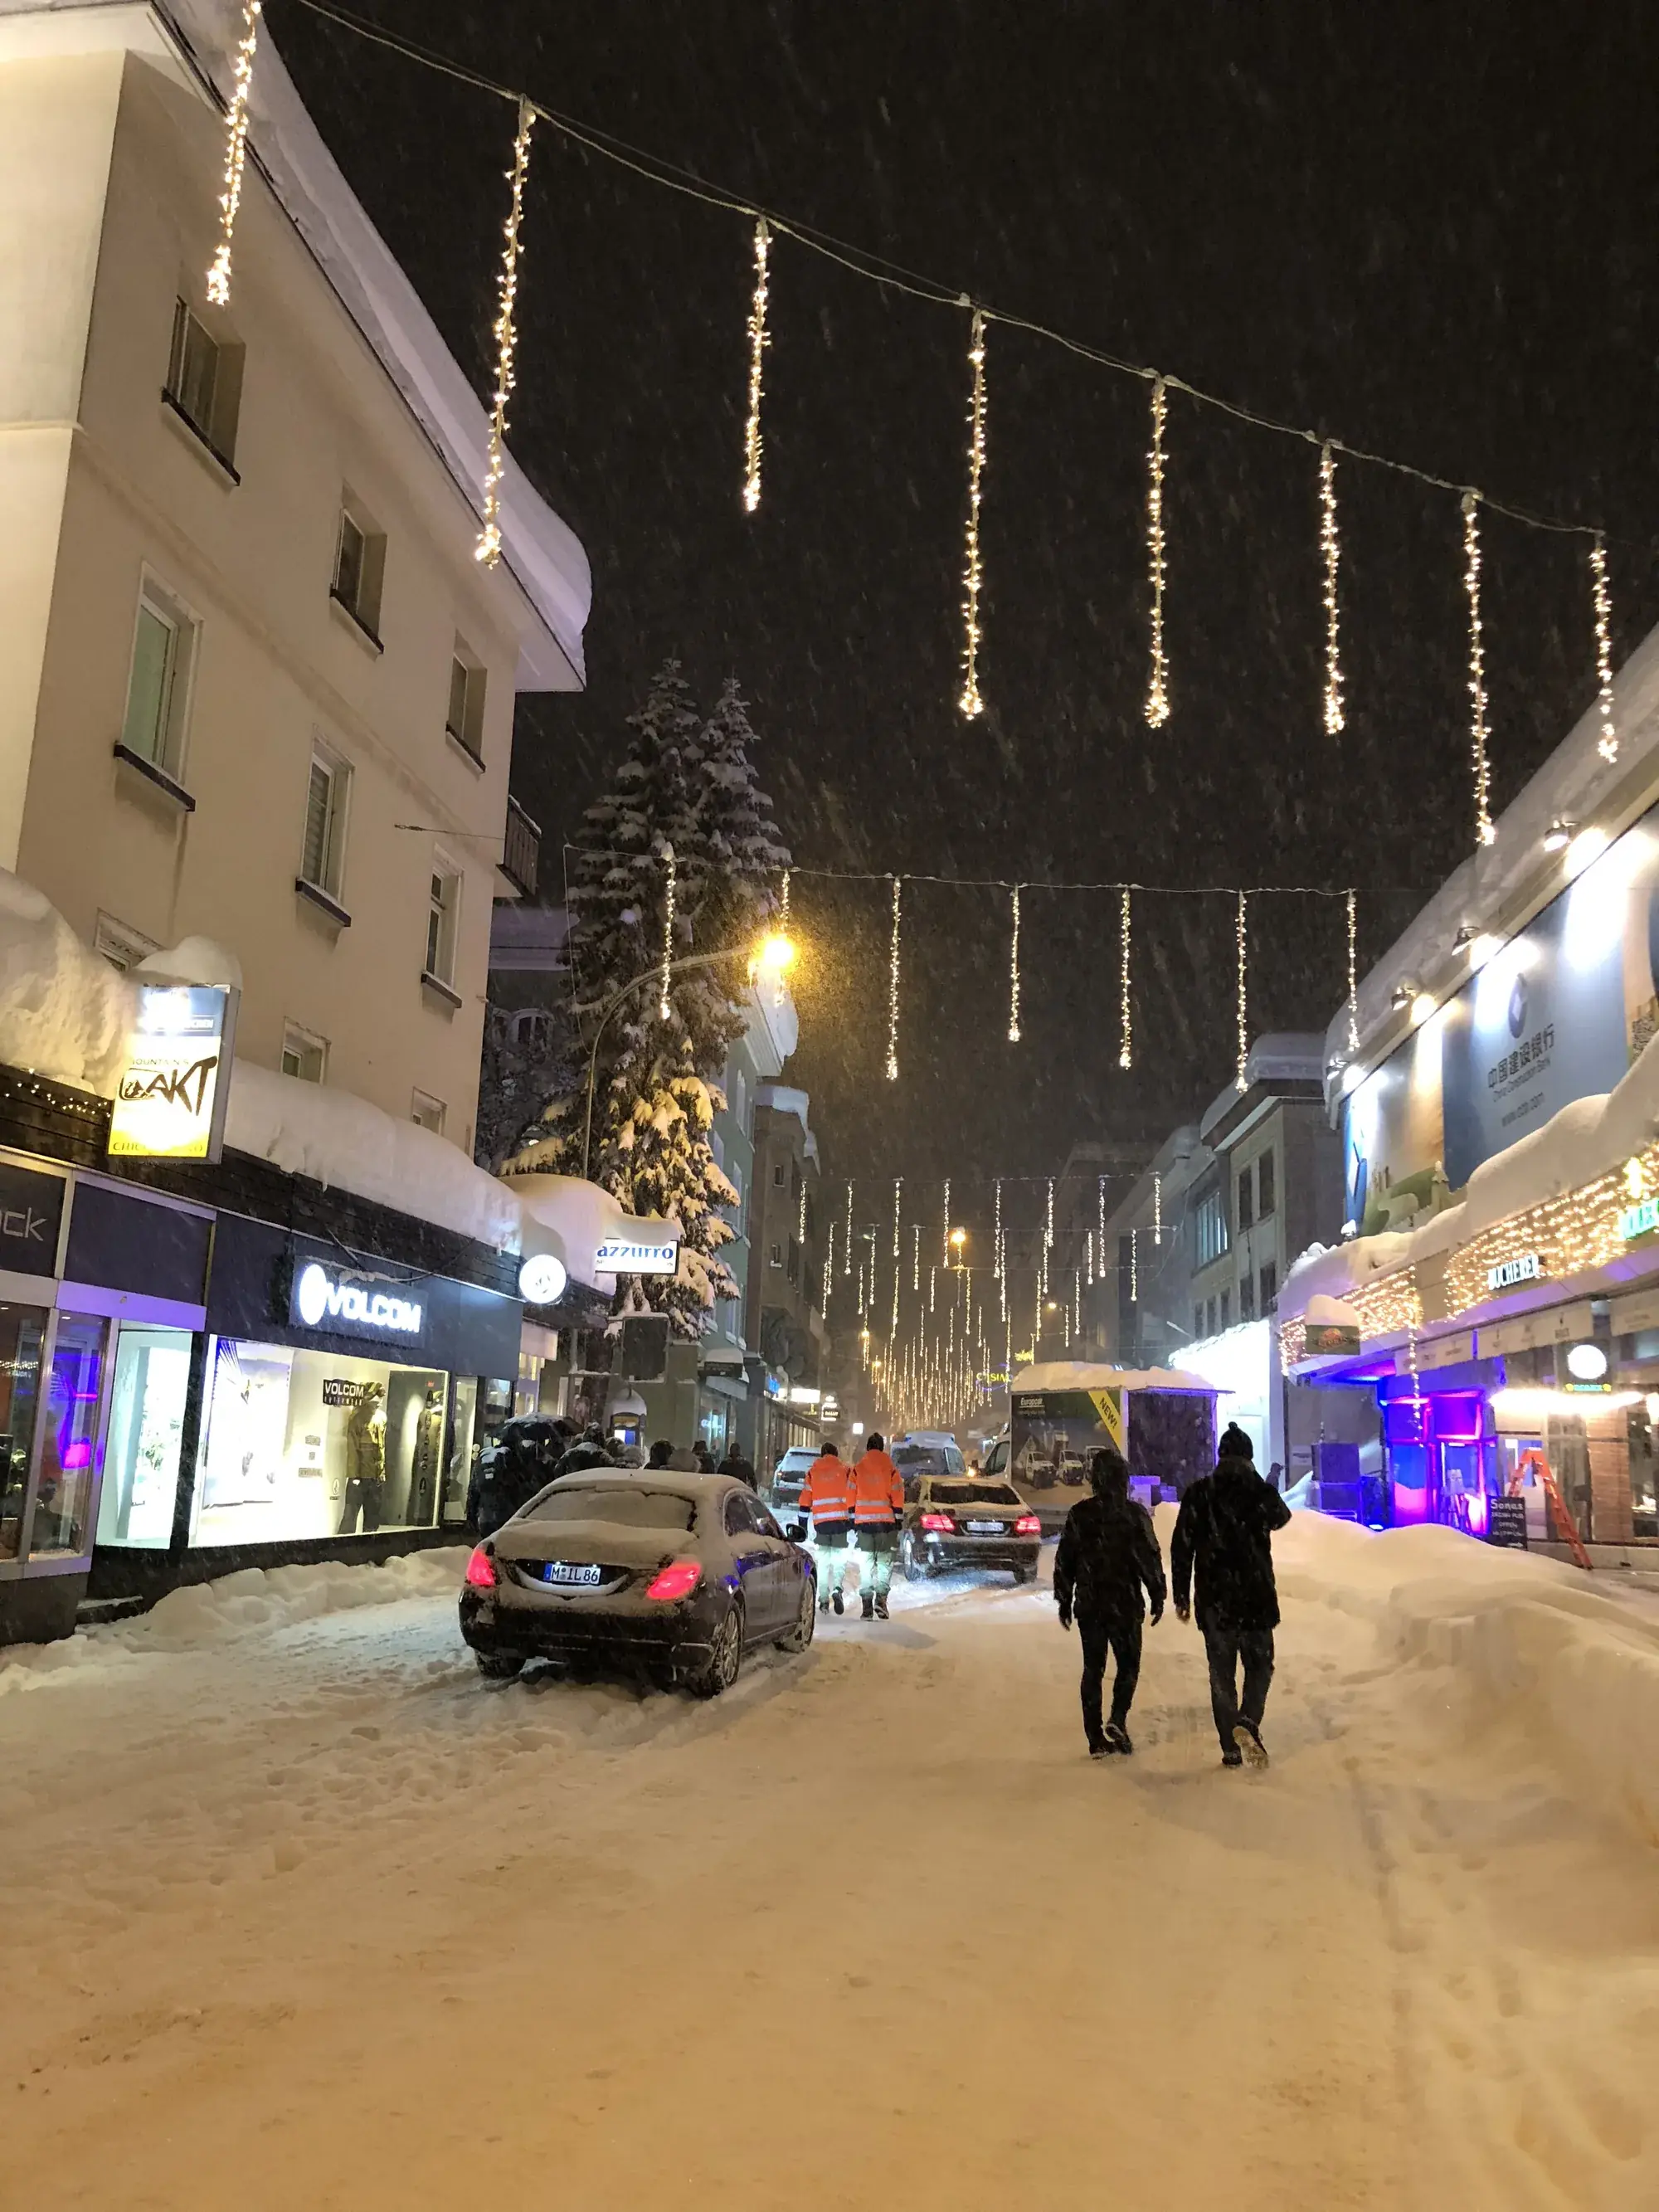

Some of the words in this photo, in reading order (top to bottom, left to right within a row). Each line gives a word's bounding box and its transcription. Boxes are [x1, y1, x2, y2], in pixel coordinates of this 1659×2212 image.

[0, 1207, 47, 1241] ck
[597, 1245, 674, 1259] azzurro
[327, 1282, 421, 1333] VOLCOM
[324, 1381, 364, 1397] VOLCOM
[1099, 1396, 1117, 1430] NEW!
[583, 1569, 598, 1582] 86
